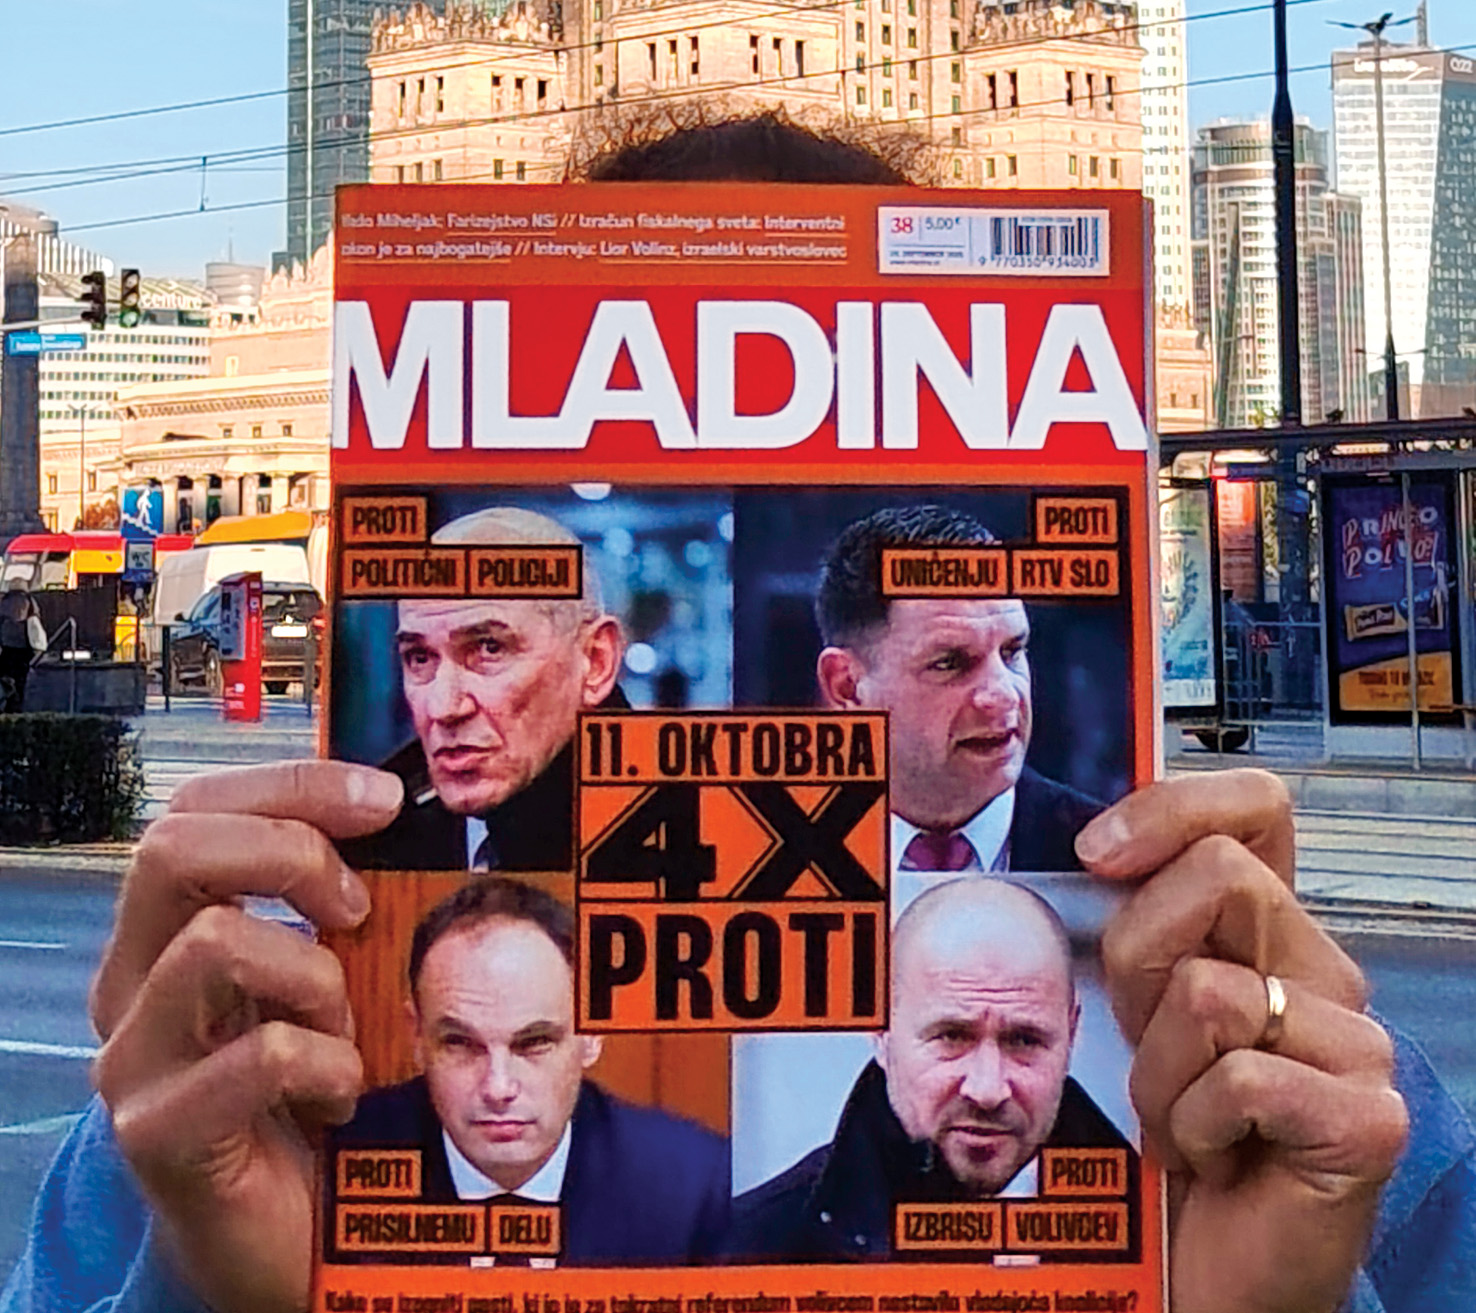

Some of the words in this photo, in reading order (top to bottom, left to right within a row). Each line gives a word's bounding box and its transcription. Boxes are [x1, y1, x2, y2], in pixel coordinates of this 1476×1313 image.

[447, 213, 528, 231] Farizejstvo
[637, 213, 713, 232] fiskalnega
[764, 215, 845, 230] Interventni
[890, 217, 913, 234] 38
[377, 241, 392, 259] je
[395, 244, 413, 255] za
[416, 241, 512, 259] najbogatejše
[332, 299, 1149, 451] MLADINA
[352, 505, 417, 534] PROTI
[1044, 506, 1109, 535] PROTI
[352, 550, 456, 587] POLITIČNI
[477, 558, 571, 587] POLICIJI
[890, 551, 998, 587] UNIČENJU
[1021, 558, 1062, 587] RTV
[1069, 558, 1109, 587] SLO
[587, 722, 638, 777] 11.
[658, 722, 876, 776] OKTOBRA
[588, 911, 877, 1020] PROTI
[345, 1158, 413, 1188] PROTI
[1051, 1157, 1119, 1187] PROTI
[344, 1213, 476, 1243] PRISILNEMU
[499, 1215, 551, 1244] DELU
[904, 1212, 993, 1240] IZBRISU
[1016, 1212, 1119, 1242] VOLIVCEV
